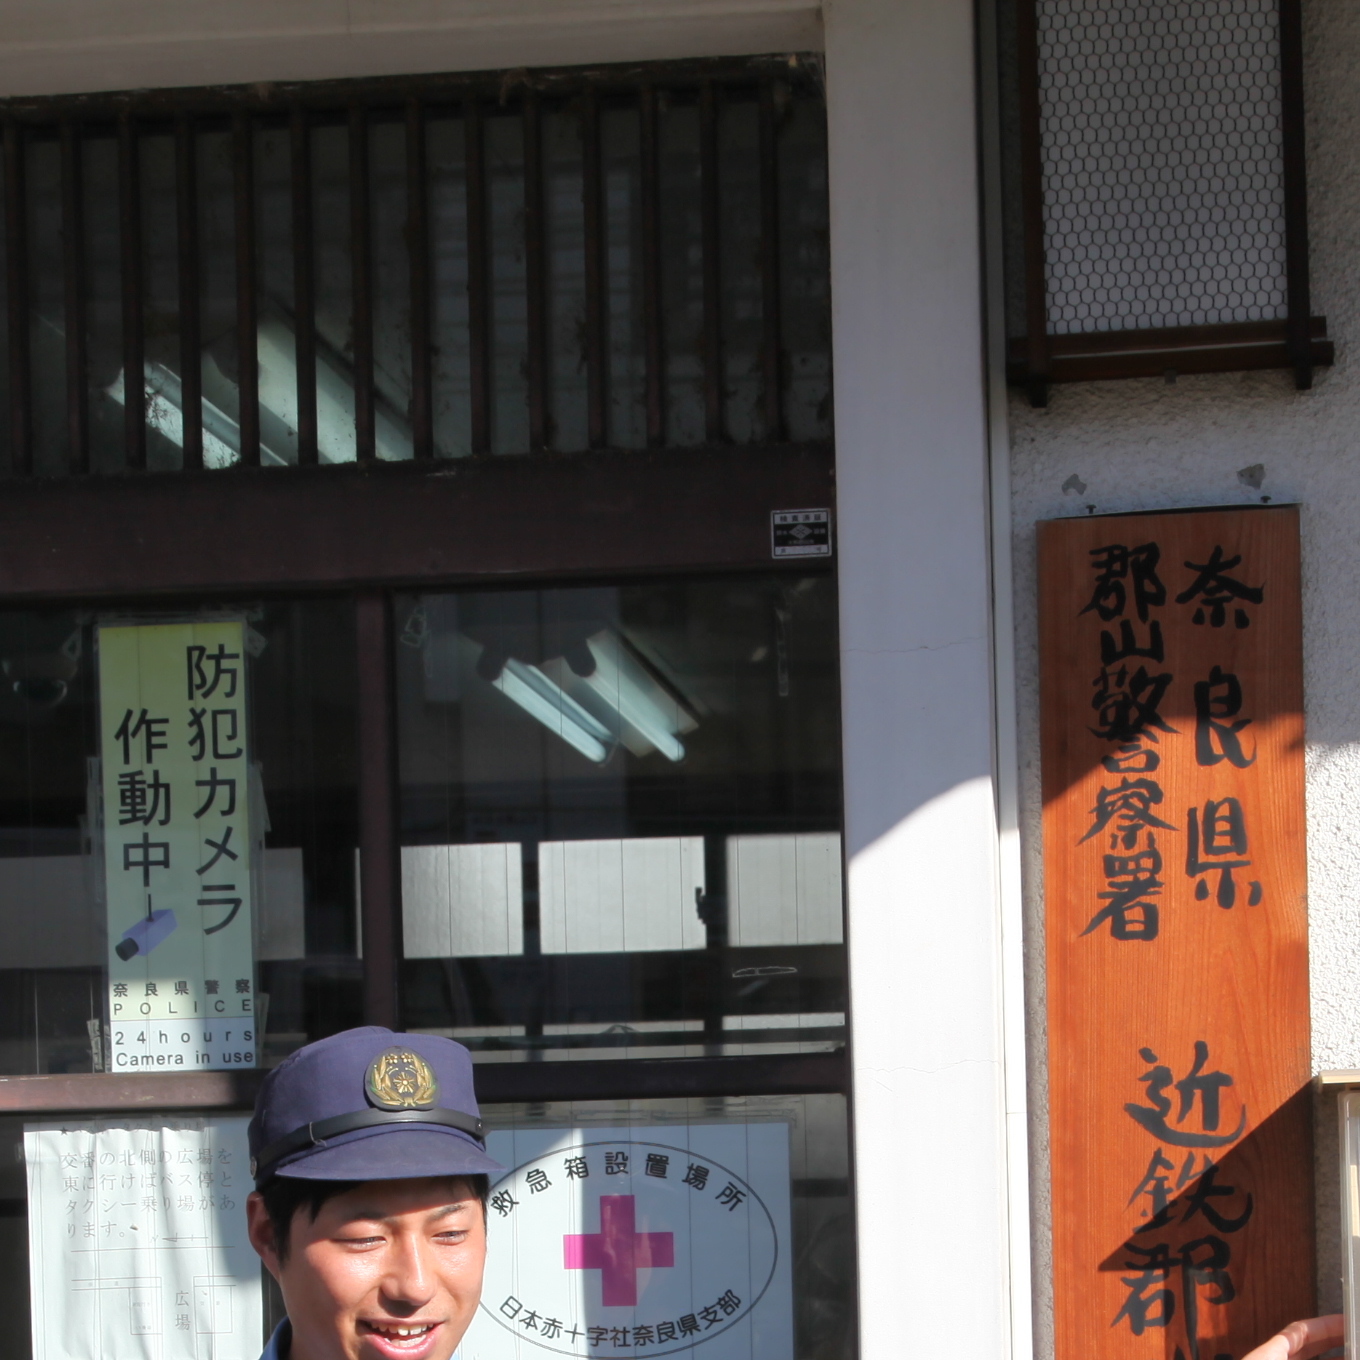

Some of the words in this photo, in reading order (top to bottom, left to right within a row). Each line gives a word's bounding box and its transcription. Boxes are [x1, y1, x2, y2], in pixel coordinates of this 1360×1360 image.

[1076, 541, 1182, 942] 郡山警察署
[1175, 544, 1264, 910] 奈良県
[114, 707, 171, 887] 作動中
[186, 643, 242, 936] 防犯カメラ
[113, 979, 251, 998] 奈良県警察
[113, 999, 252, 1016] POLICE
[116, 1051, 184, 1068] Camera
[195, 1050, 210, 1064] in
[222, 1051, 254, 1064] use
[60, 1147, 233, 1170] 交番の北側の広場を
[63, 1171, 233, 1192] 東に行けばバス停と
[490, 1151, 747, 1218] 救急箱設置場所
[66, 1195, 236, 1215] タクシー乗り場があ
[67, 1221, 125, 1239] ります。
[175, 1290, 191, 1331] 広場
[499, 1288, 742, 1348] 日本赤十字社奈良県支部
